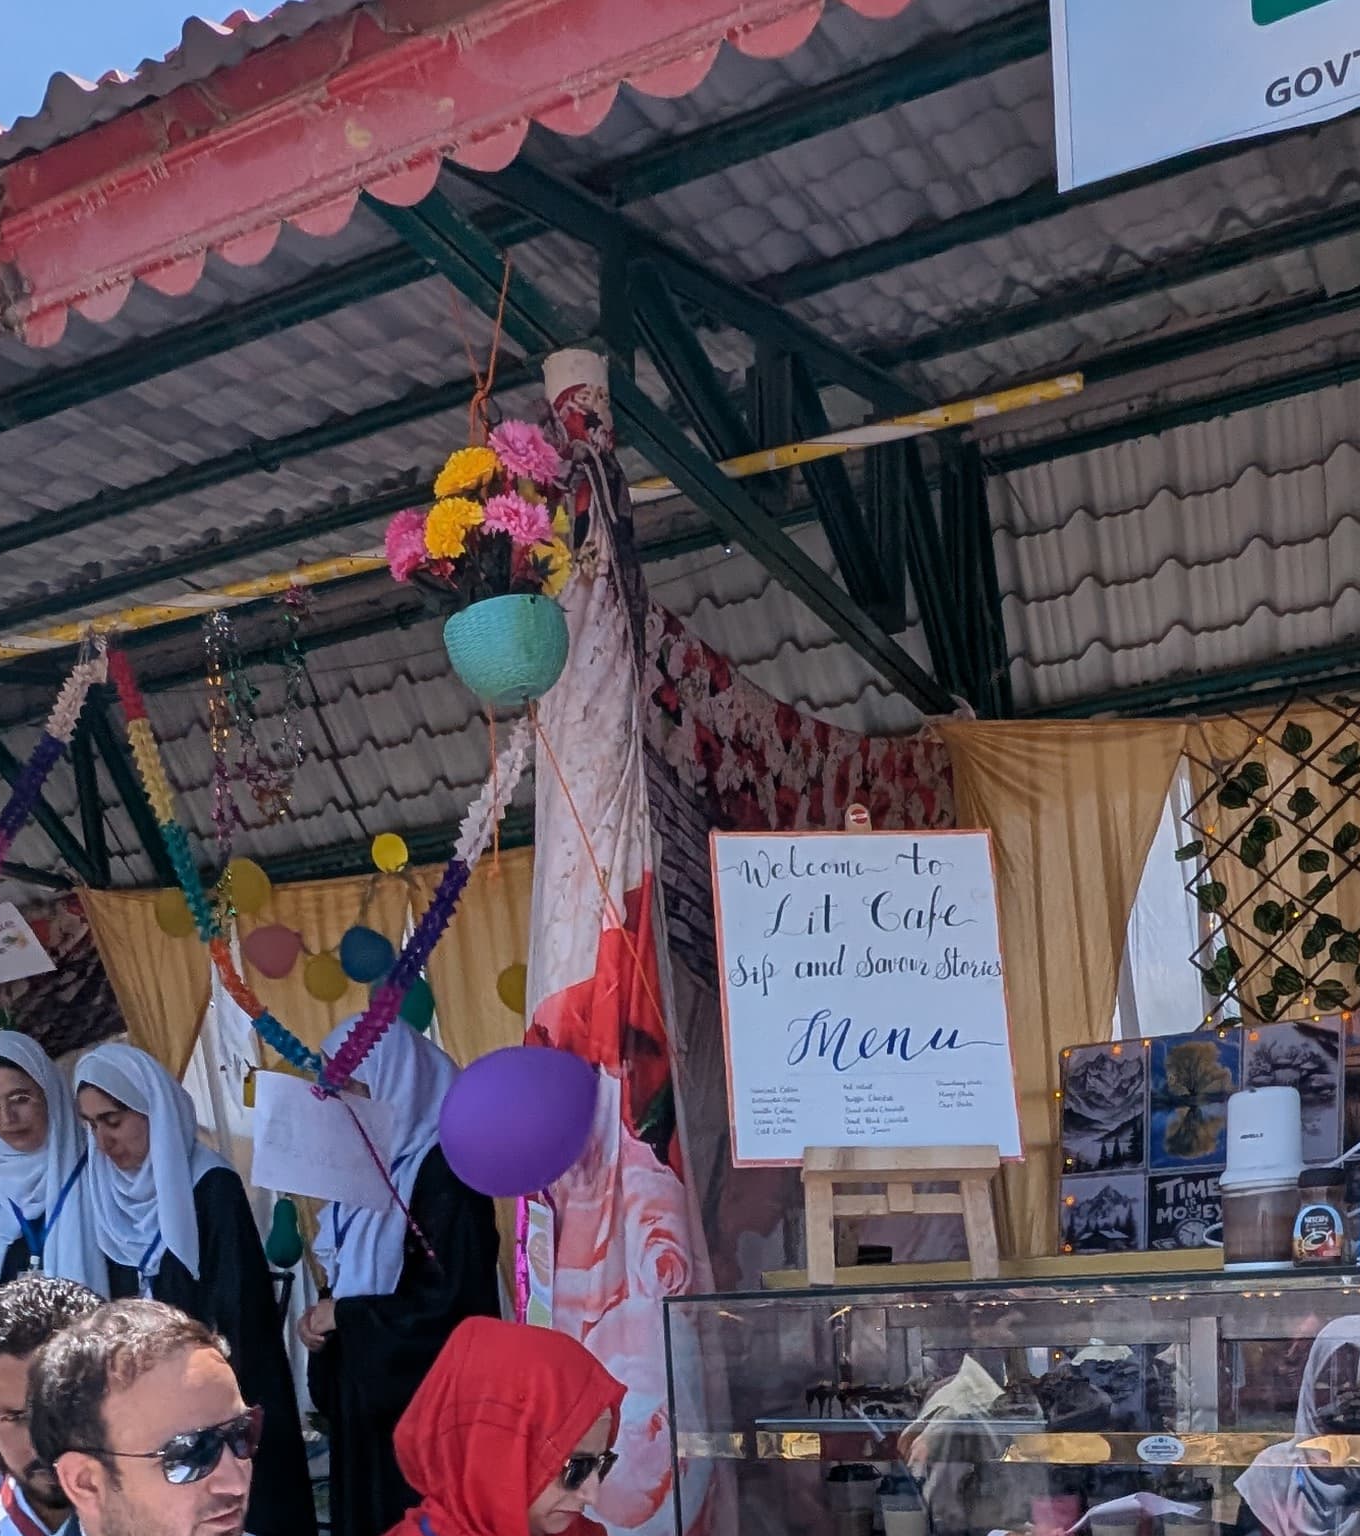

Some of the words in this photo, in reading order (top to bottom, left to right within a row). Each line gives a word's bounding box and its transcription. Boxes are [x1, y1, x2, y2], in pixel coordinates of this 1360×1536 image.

[717, 845, 889, 889] Welcome
[896, 842, 954, 877] to
[763, 893, 843, 938] Lit
[862, 885, 978, 942] Cafe
[729, 954, 779, 997] Sip
[794, 944, 846, 979] and
[856, 946, 931, 979] Savour
[934, 947, 1003, 980] Stories
[788, 1009, 1005, 1071] Menu
[1156, 1176, 1221, 1204] TIME
[1156, 1203, 1223, 1225] MONEY
